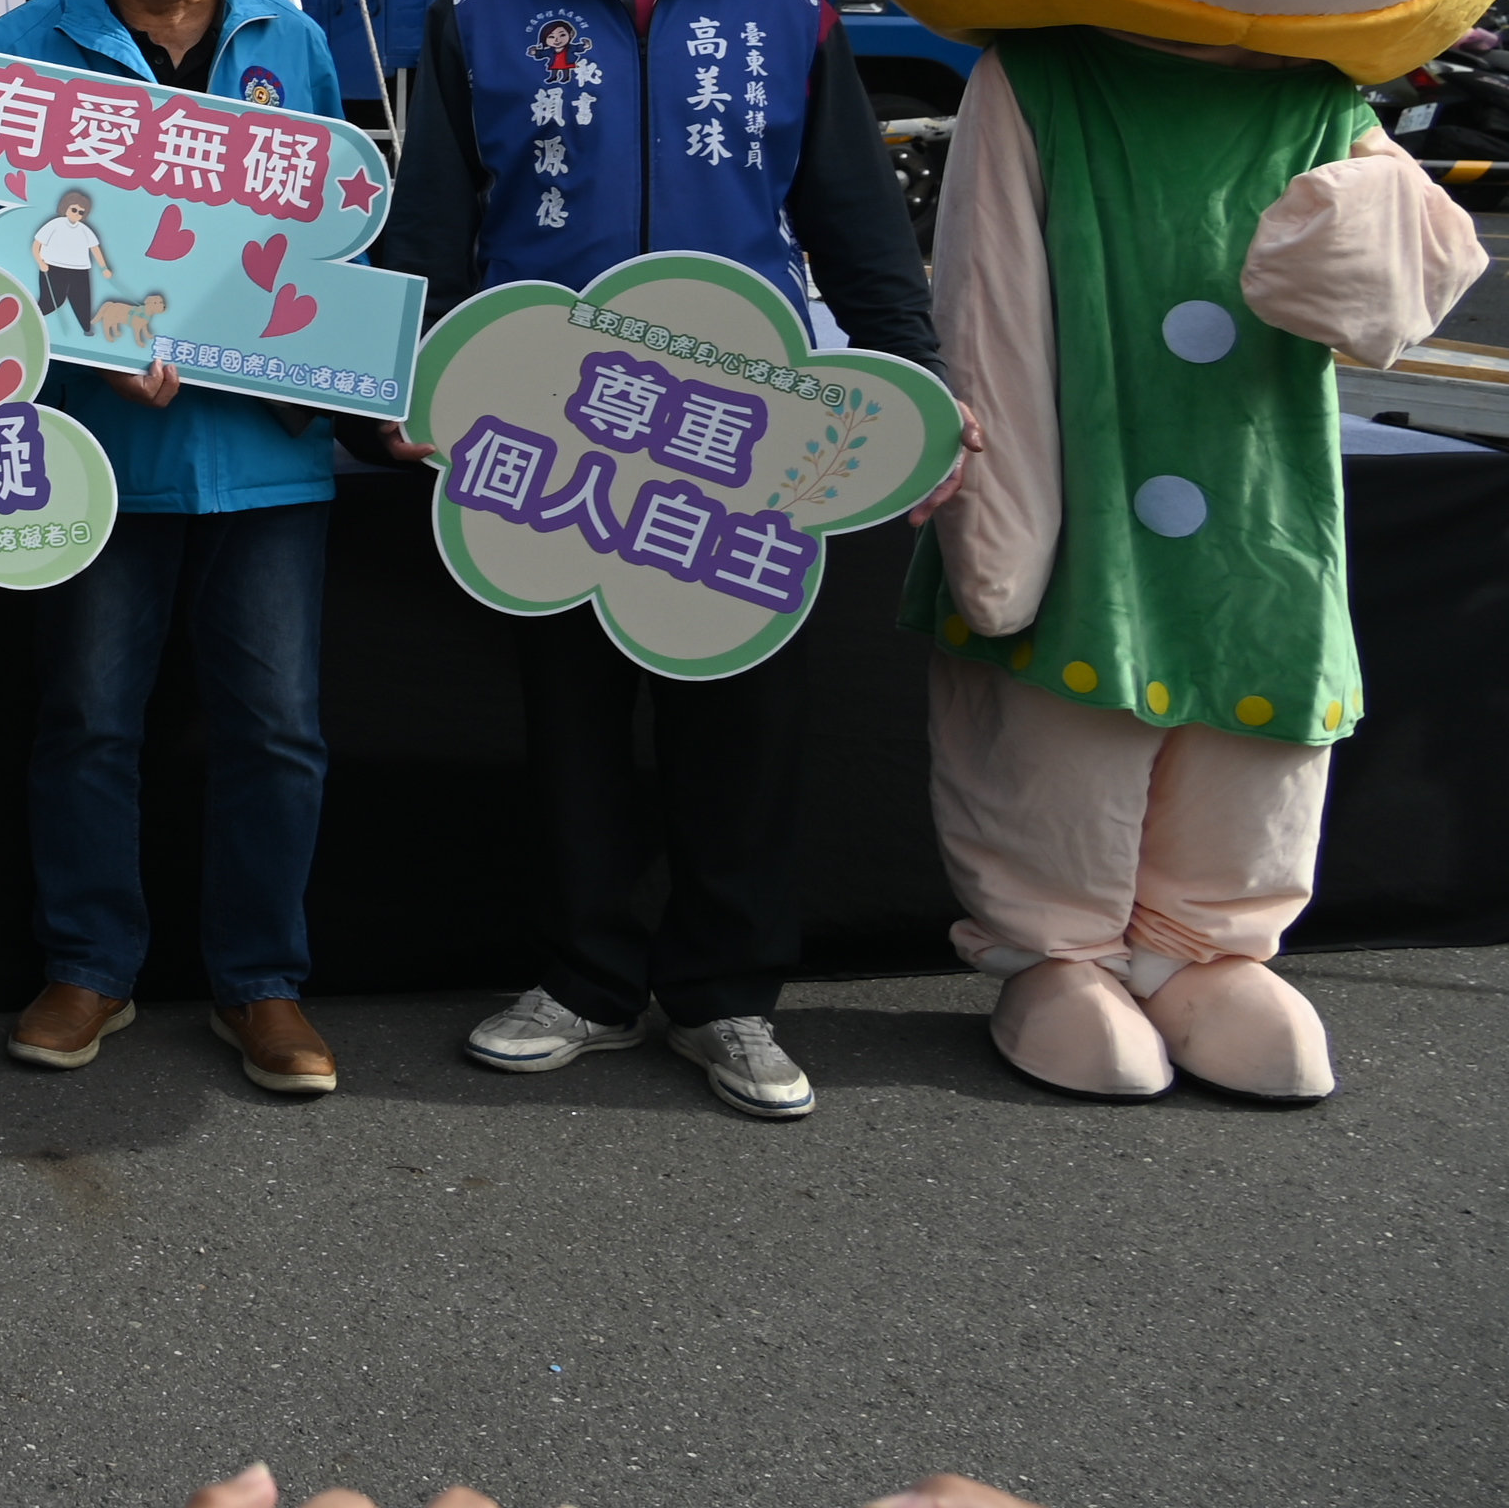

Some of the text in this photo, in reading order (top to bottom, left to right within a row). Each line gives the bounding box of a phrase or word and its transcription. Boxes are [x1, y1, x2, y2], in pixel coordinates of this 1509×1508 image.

[685, 16, 733, 167] 高美珠
[740, 21, 768, 171] 臺東縣議員
[151, 335, 400, 402] 臺東縣國際身心障礙者日
[567, 300, 847, 409] 臺東縣國際身心障礙者日
[578, 363, 754, 475] 尊重
[458, 428, 804, 601] 個人自主
